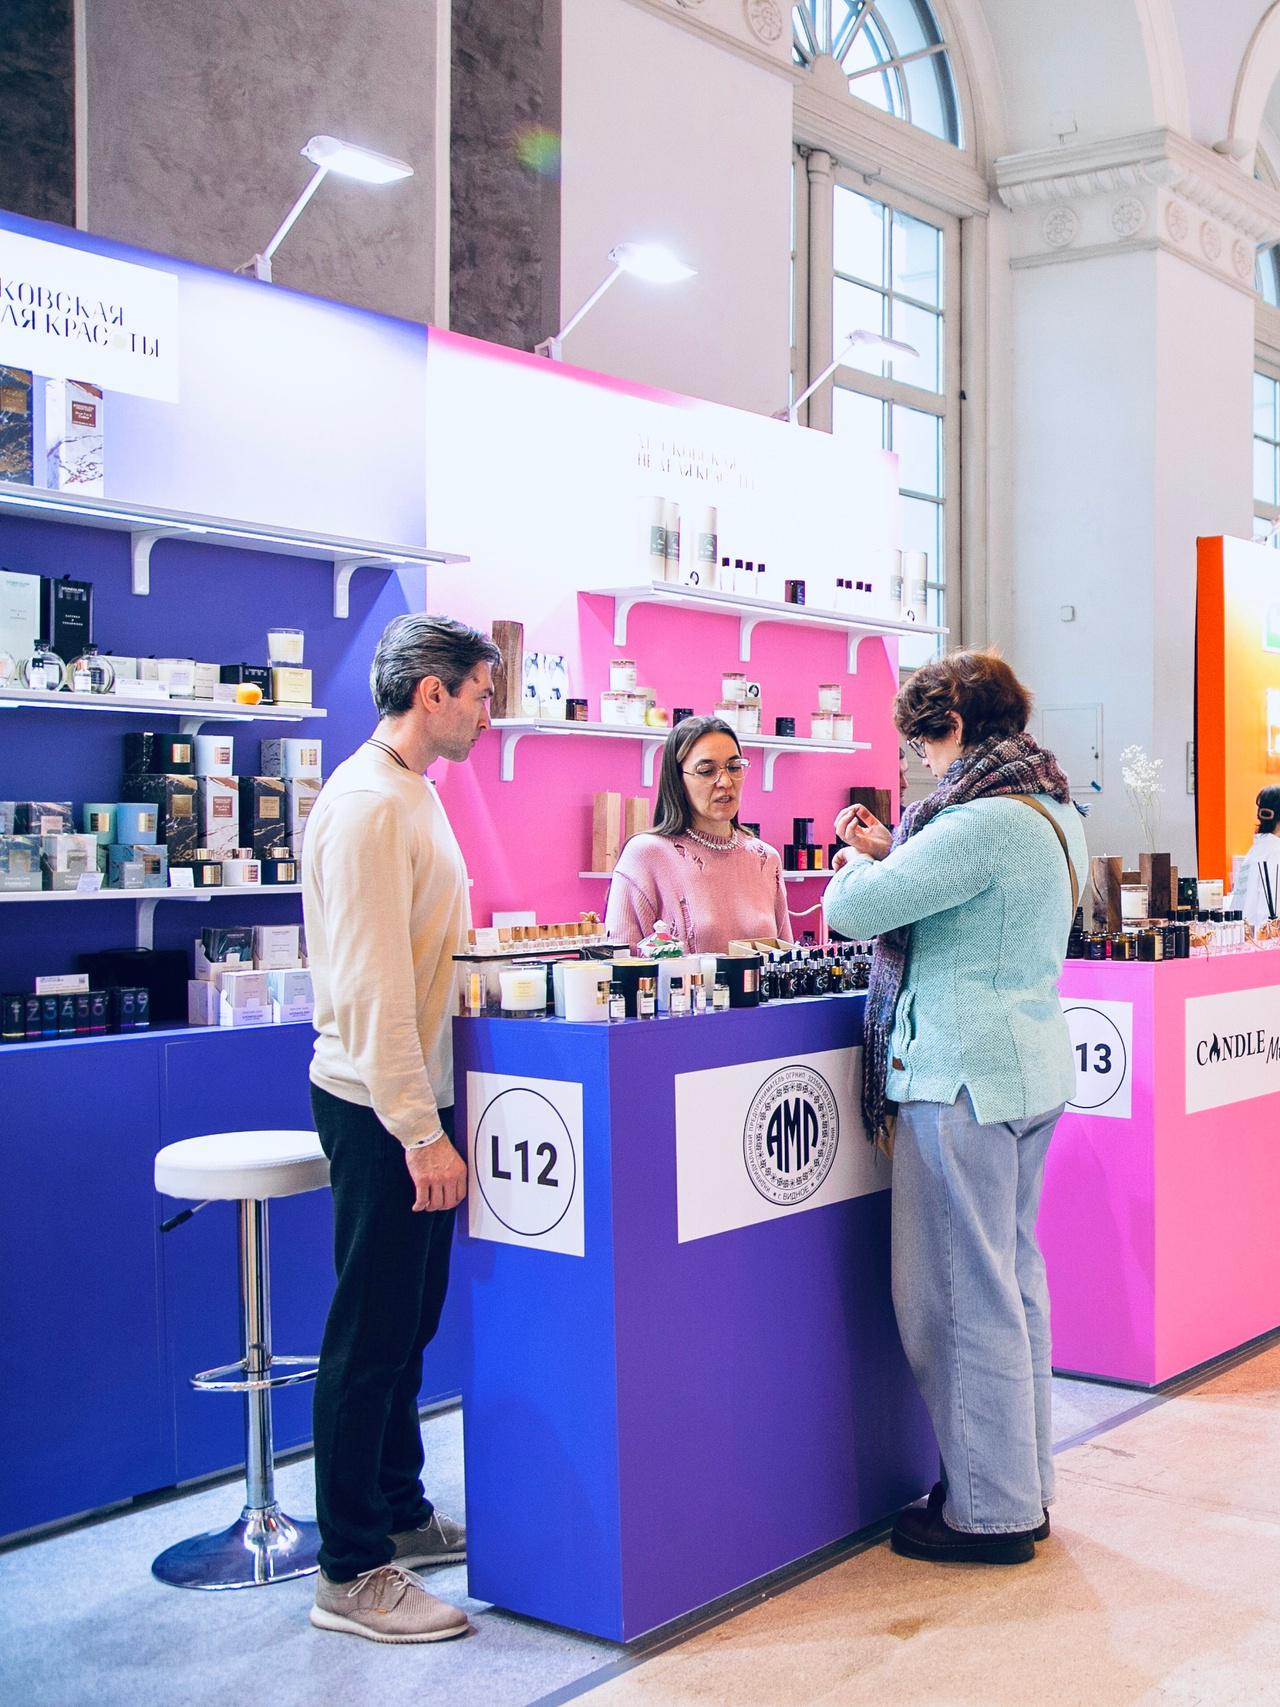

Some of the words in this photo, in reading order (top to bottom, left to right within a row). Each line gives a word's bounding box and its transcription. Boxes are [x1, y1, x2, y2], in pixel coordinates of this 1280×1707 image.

[26, 1000, 40, 1020] 2
[44, 999, 57, 1020] 3
[1075, 1042, 1112, 1074] 13
[1196, 1029, 1266, 1066] CANDLE
[785, 1072, 806, 1080] ОГРНИП
[749, 1075, 785, 1132] ПРЕДПРИНИМАТЕЛЬ
[767, 1097, 819, 1174] АМП
[491, 1135, 559, 1188] L12
[748, 1133, 771, 1193] ИНДИВИДУАЛЬНЫЙ
[783, 1187, 810, 1200] ВИДНОЕ
